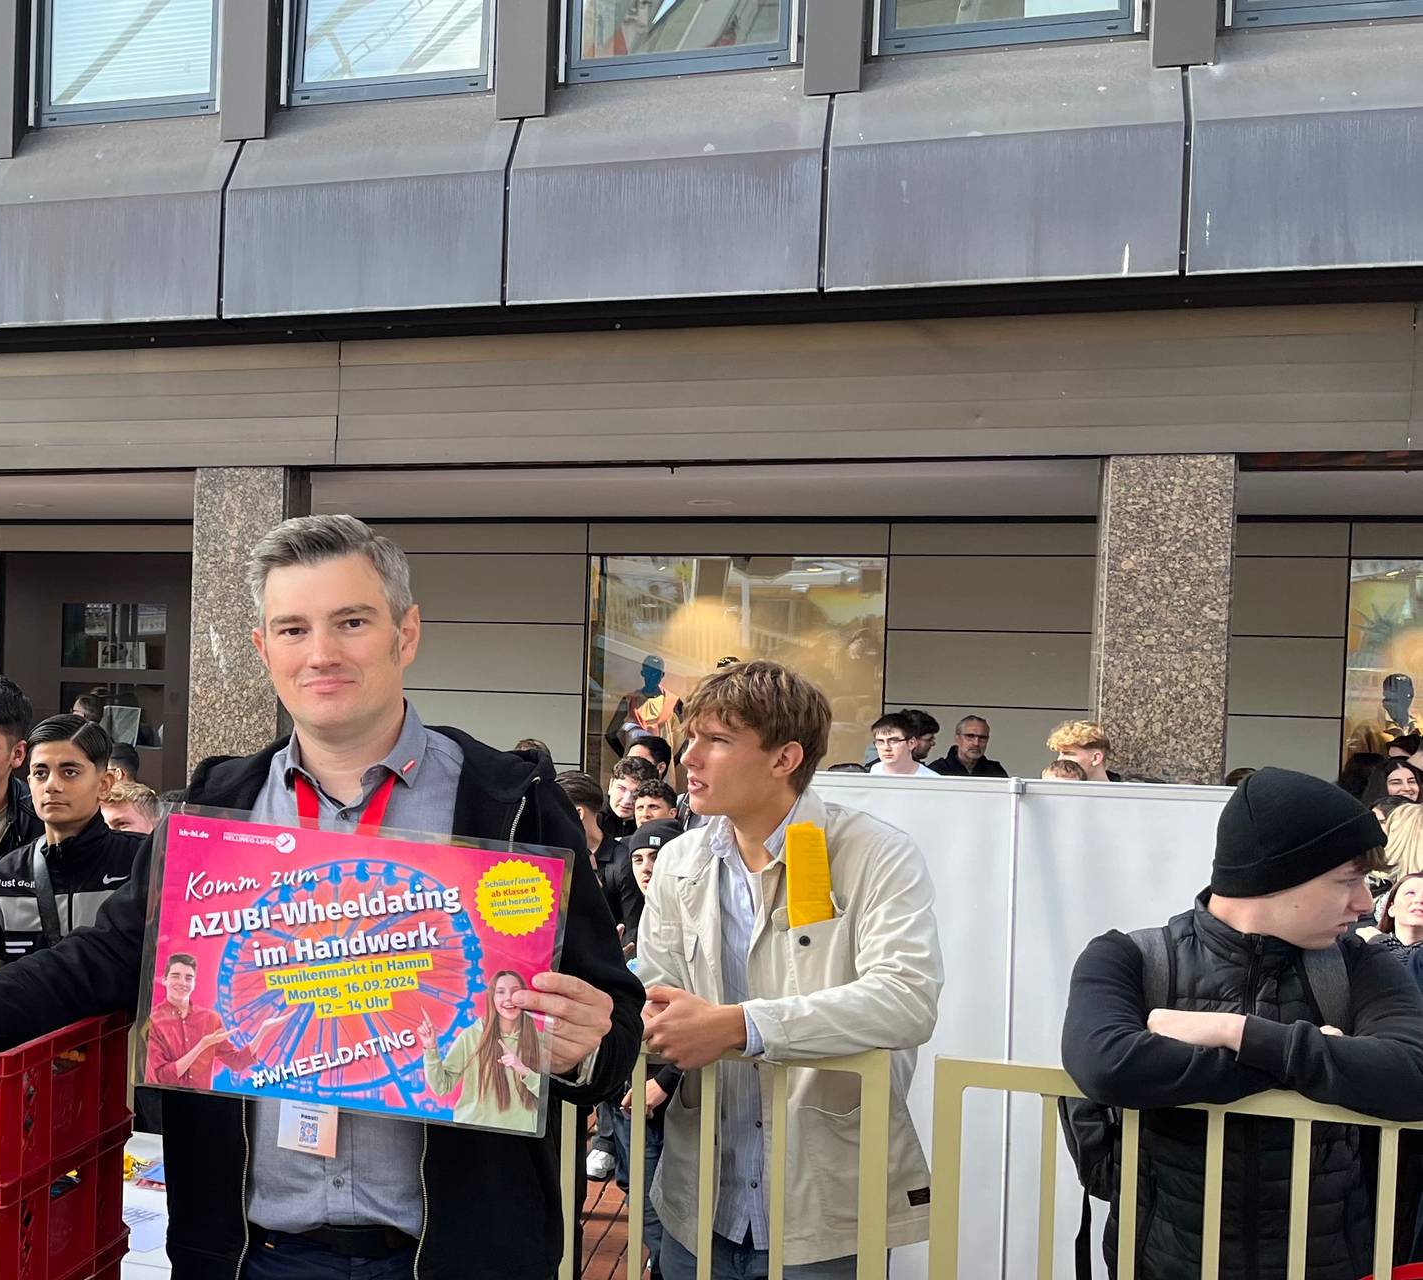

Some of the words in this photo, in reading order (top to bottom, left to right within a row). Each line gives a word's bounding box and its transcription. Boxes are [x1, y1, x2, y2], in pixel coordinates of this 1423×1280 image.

[185, 871, 261, 901] Komm
[270, 868, 320, 889] zum
[503, 888, 529, 896] Klasse
[188, 884, 462, 939] AZUBI-Wheeldating
[253, 941, 295, 967] im
[296, 922, 440, 962] Handwerk
[268, 963, 368, 986] Stunikenmarkt
[370, 960, 383, 973] in
[387, 957, 430, 971] Hamm
[288, 984, 342, 1001] Montag,
[345, 976, 416, 994] 16.09.2024
[319, 1003, 333, 1015] 12
[347, 1000, 362, 1012] 14
[365, 996, 390, 1009] Uhr
[251, 1029, 416, 1089] #WHEELDATING
